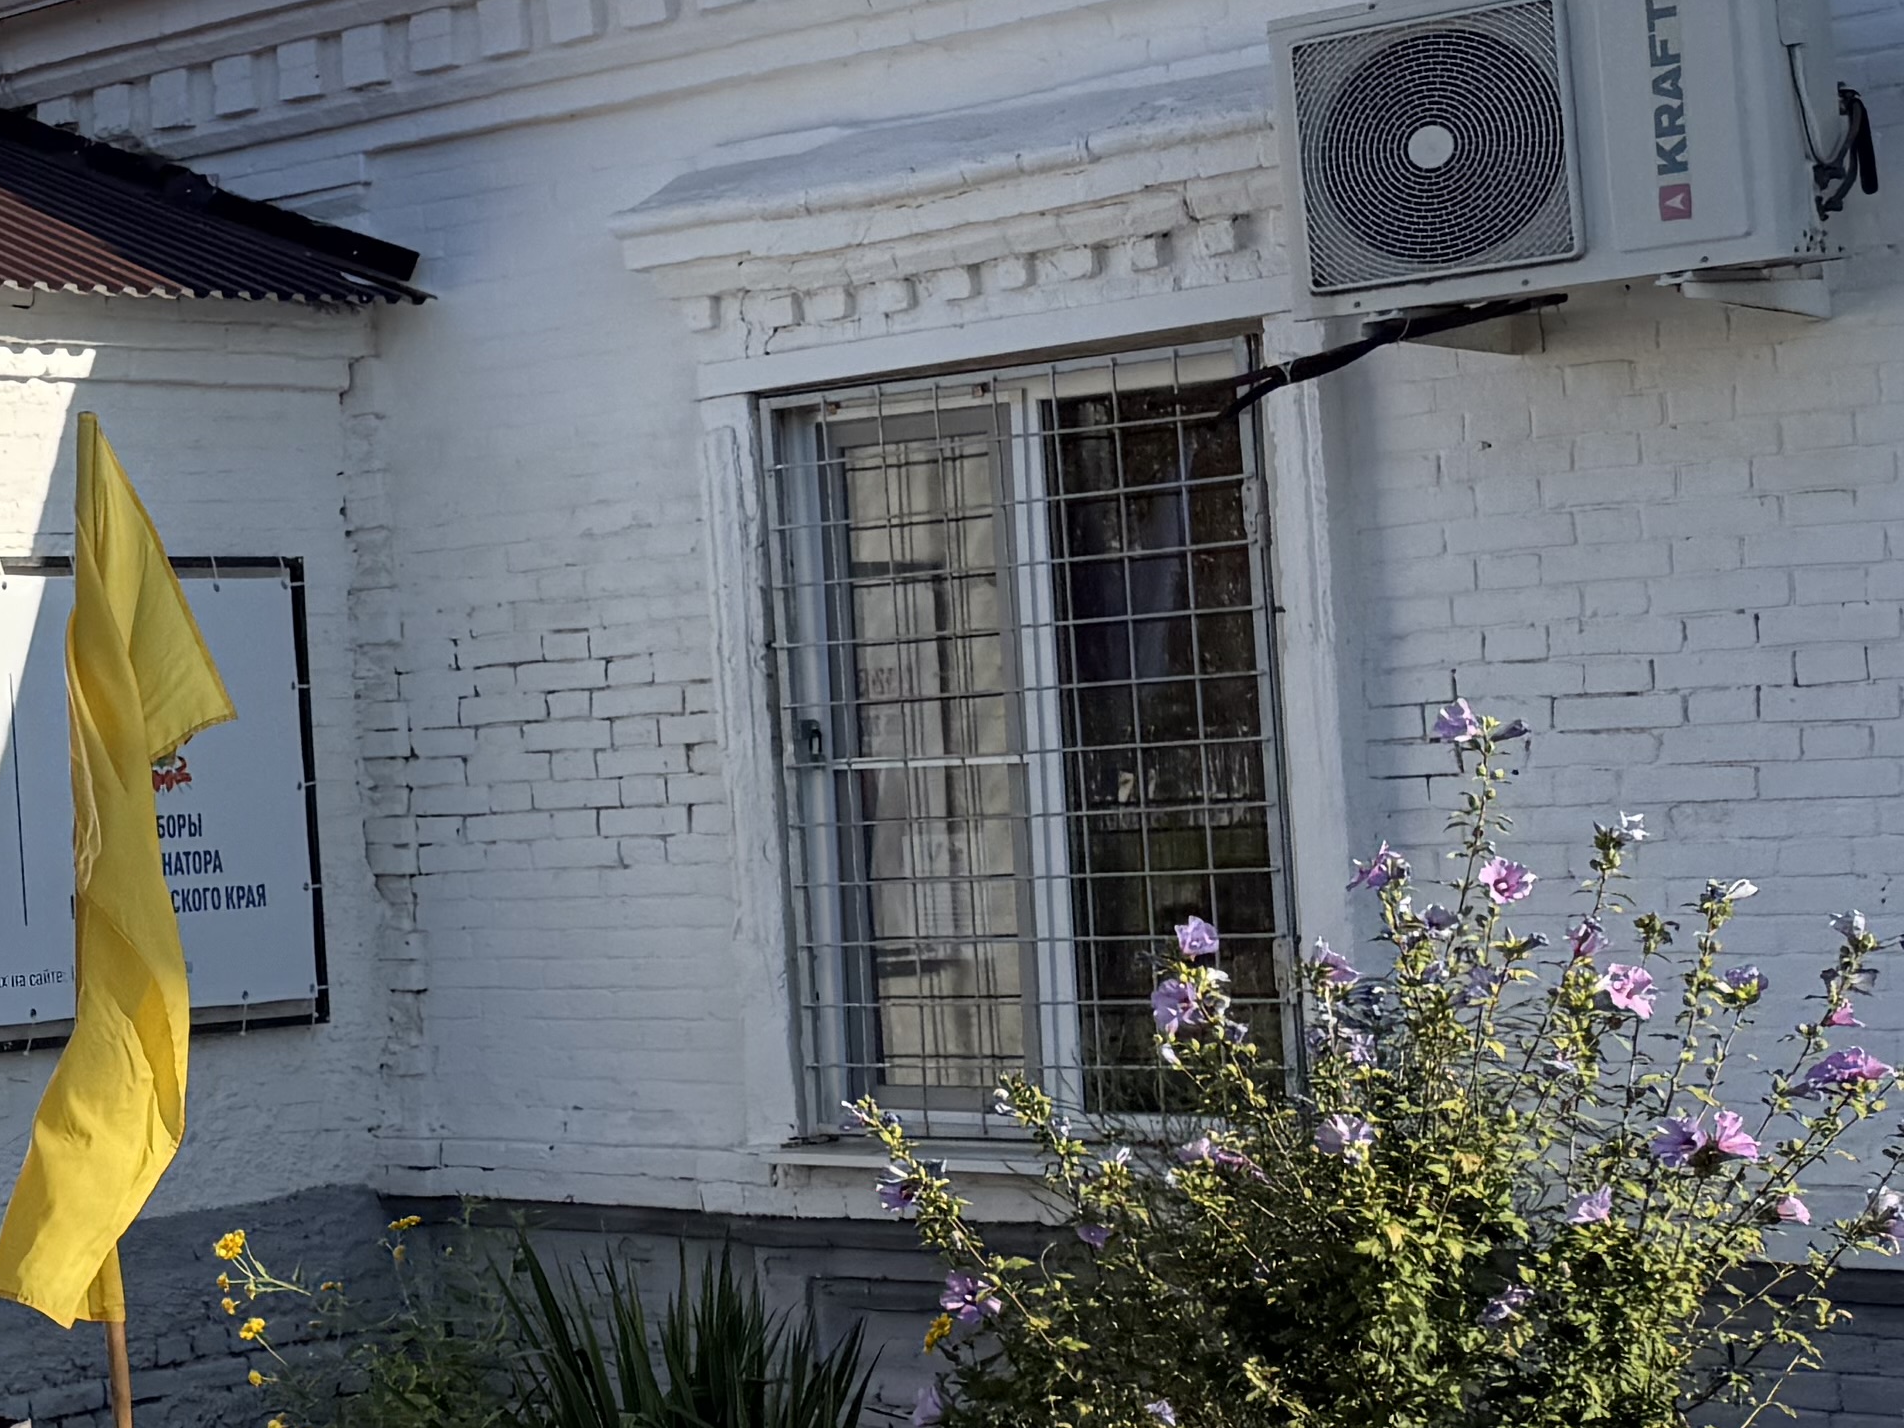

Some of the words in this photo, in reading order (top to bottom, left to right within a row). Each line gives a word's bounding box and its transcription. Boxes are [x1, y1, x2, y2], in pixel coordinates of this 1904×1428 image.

[156, 813, 203, 838] БОРЫ
[162, 849, 223, 876] НАТОРА
[225, 884, 267, 910] КРАЯ
[11, 974, 25, 988] на
